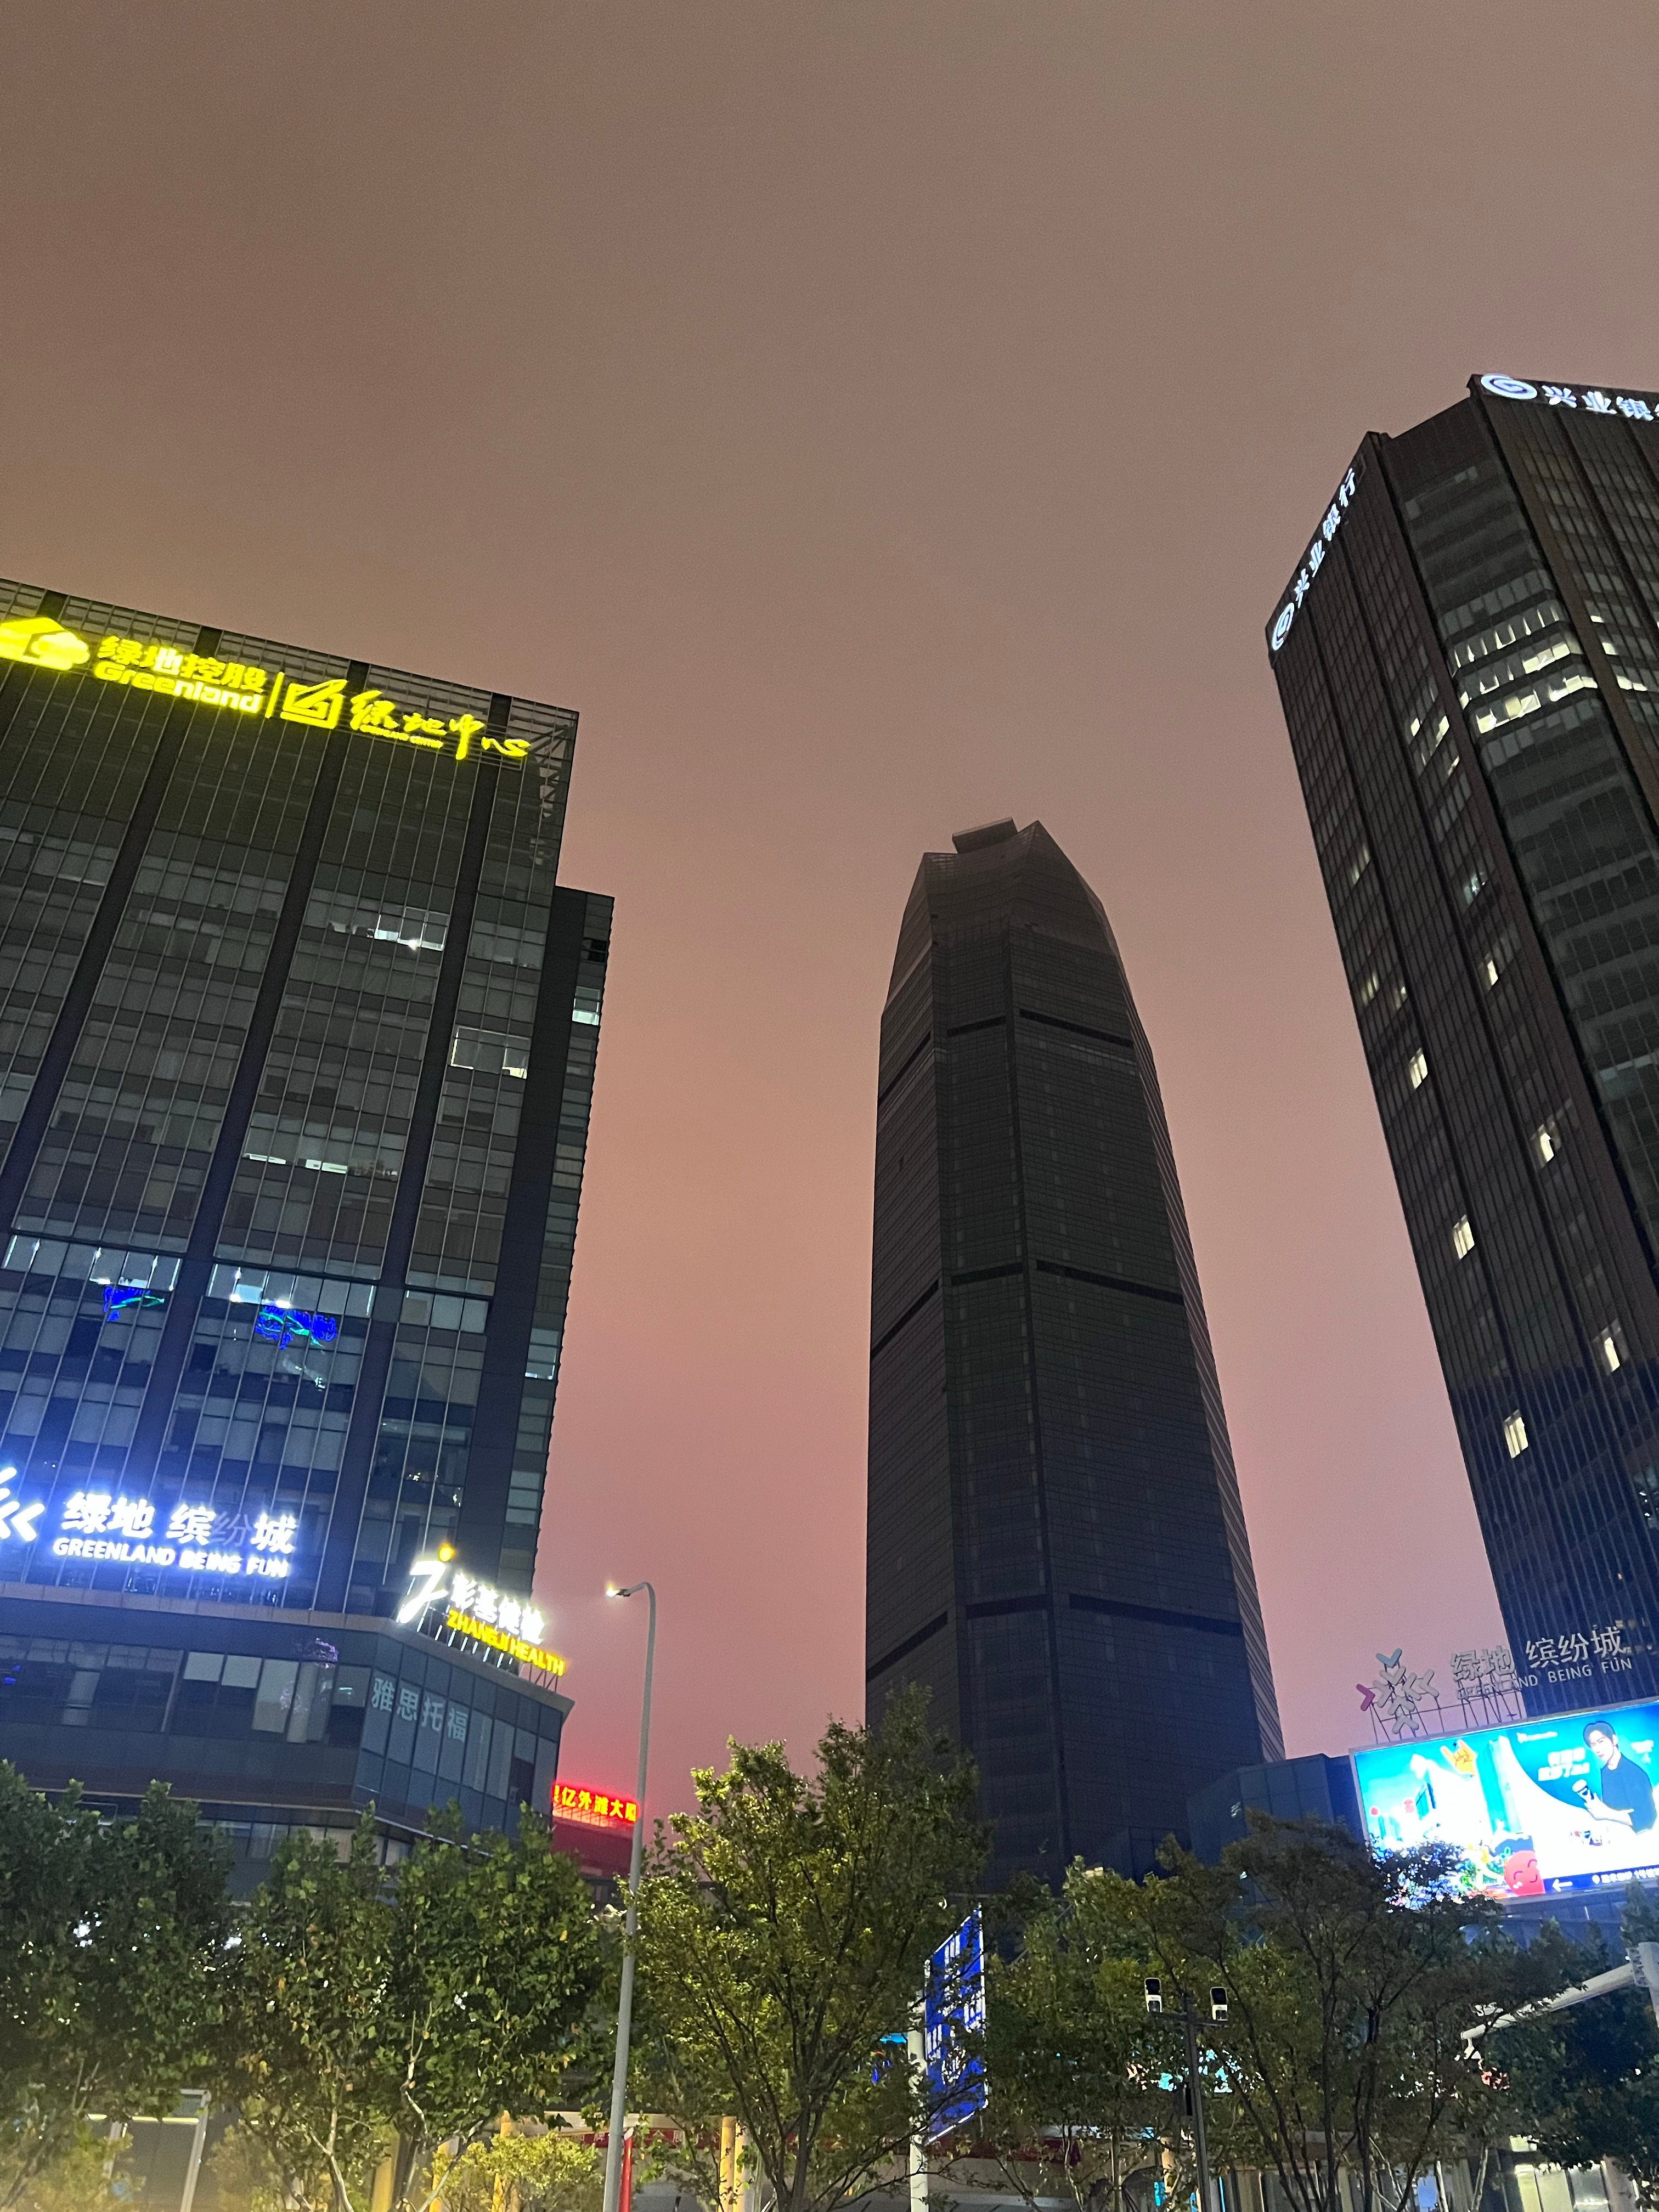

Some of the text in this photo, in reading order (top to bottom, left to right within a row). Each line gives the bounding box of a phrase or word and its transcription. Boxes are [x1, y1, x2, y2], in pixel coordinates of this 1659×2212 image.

[1542, 385, 1659, 421] 兴业银
[94, 661, 263, 714] Greenland
[97, 636, 267, 692] 绿地控股
[349, 690, 531, 760] 绿地中心
[53, 1538, 290, 1578] GREENLAND BEING FUN
[447, 1609, 565, 1677] ZHANGJI HEALTH
[1548, 1664, 1592, 1684] BEING
[1601, 1657, 1633, 1674] FUN
[371, 1677, 469, 1743] 雅思托福
